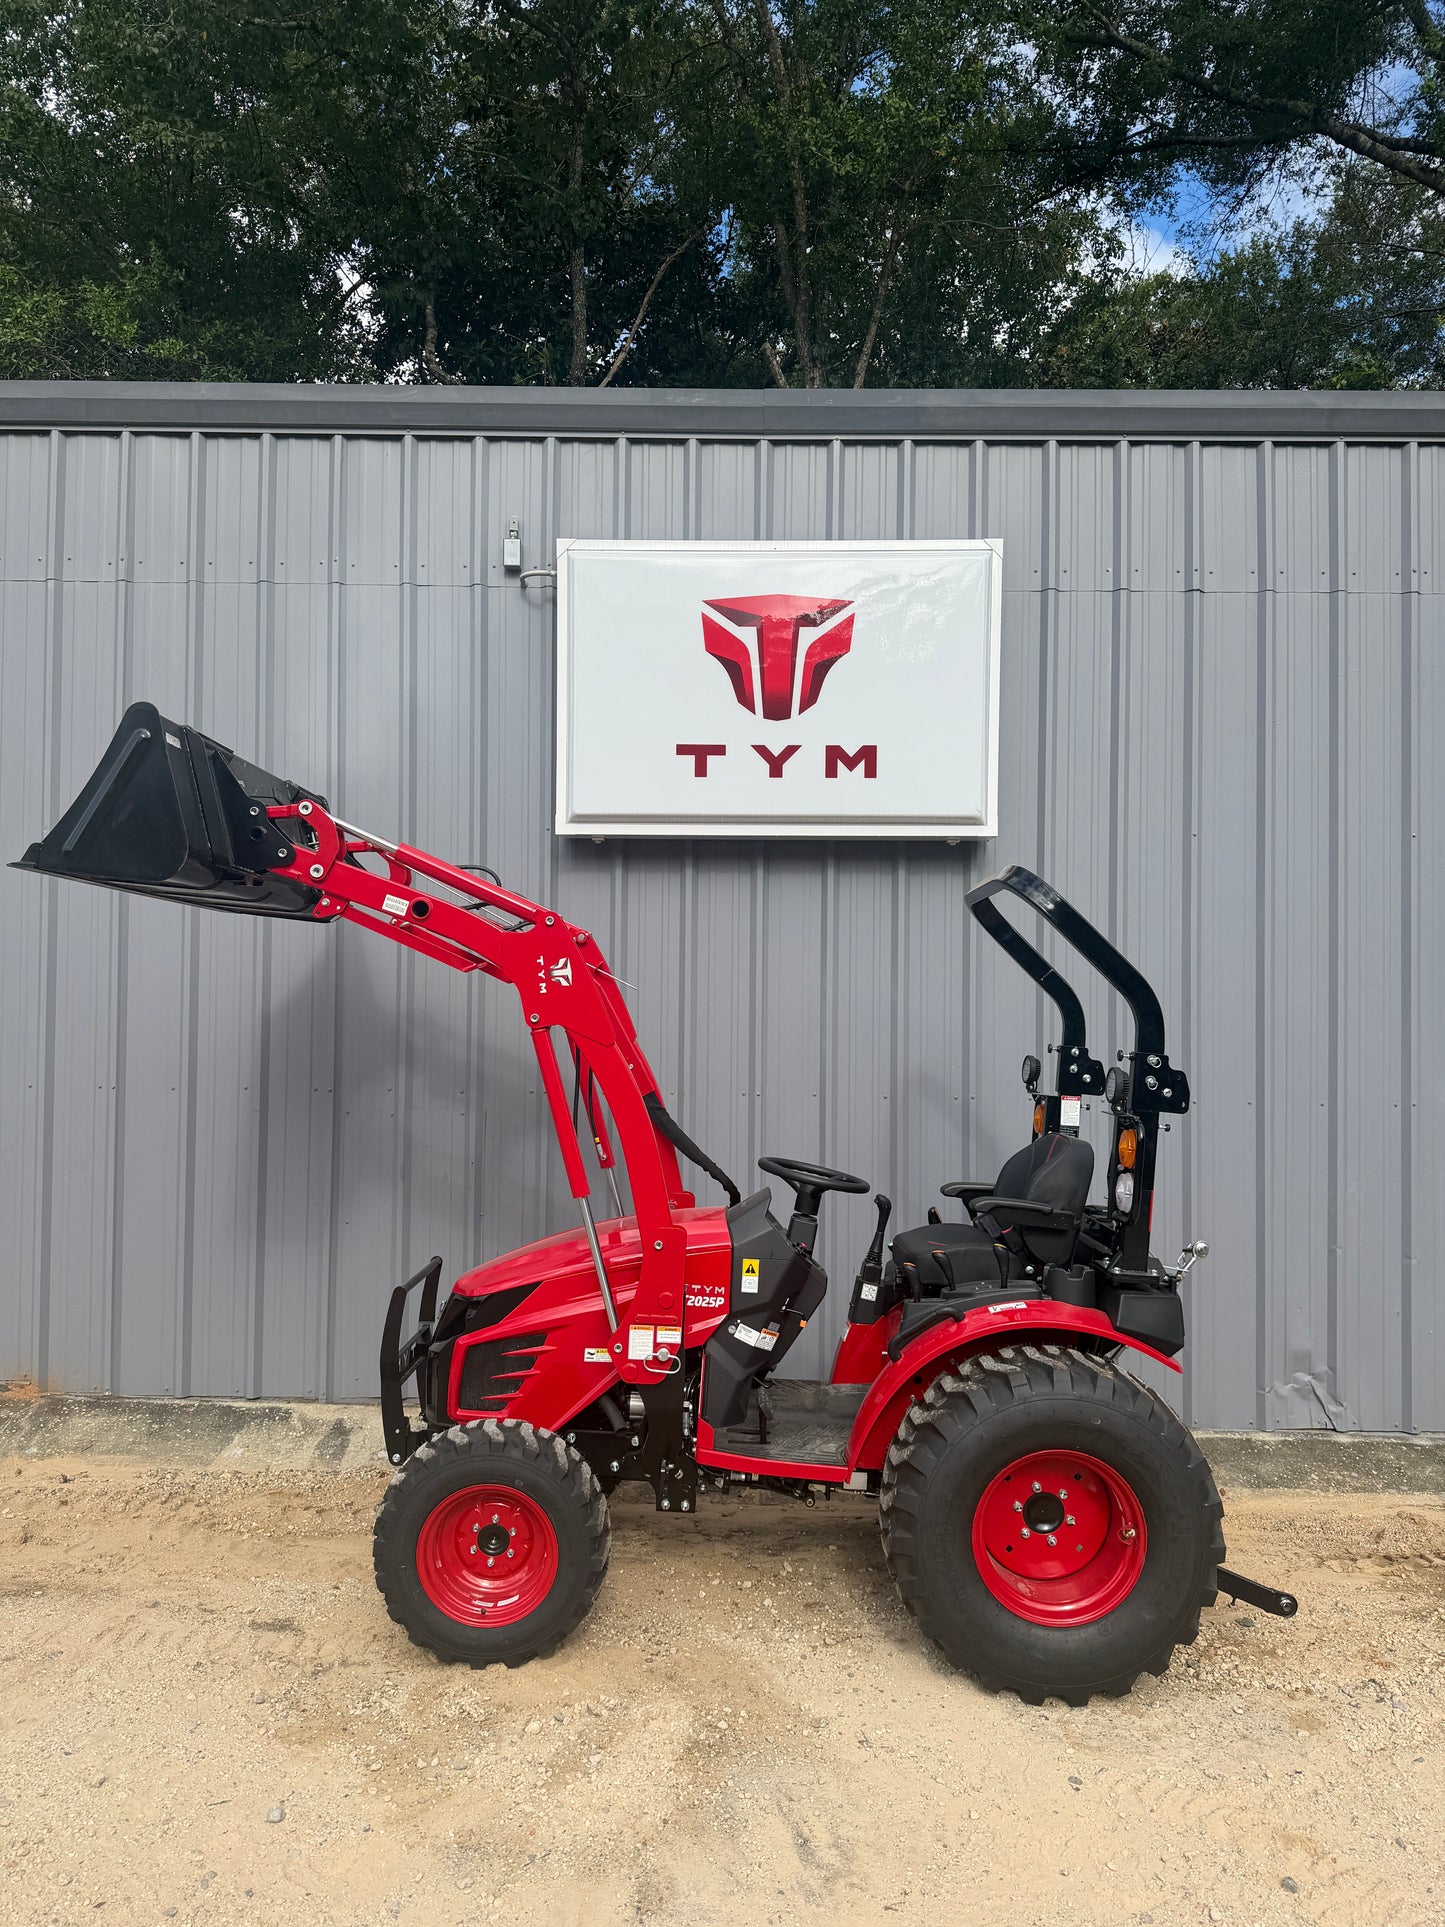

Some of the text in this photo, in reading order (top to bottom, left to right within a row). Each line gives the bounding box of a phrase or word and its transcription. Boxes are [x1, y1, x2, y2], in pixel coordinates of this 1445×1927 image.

[676, 744, 877, 778] TYM
[536, 955, 547, 994] TYM
[691, 1284, 725, 1295] TYM
